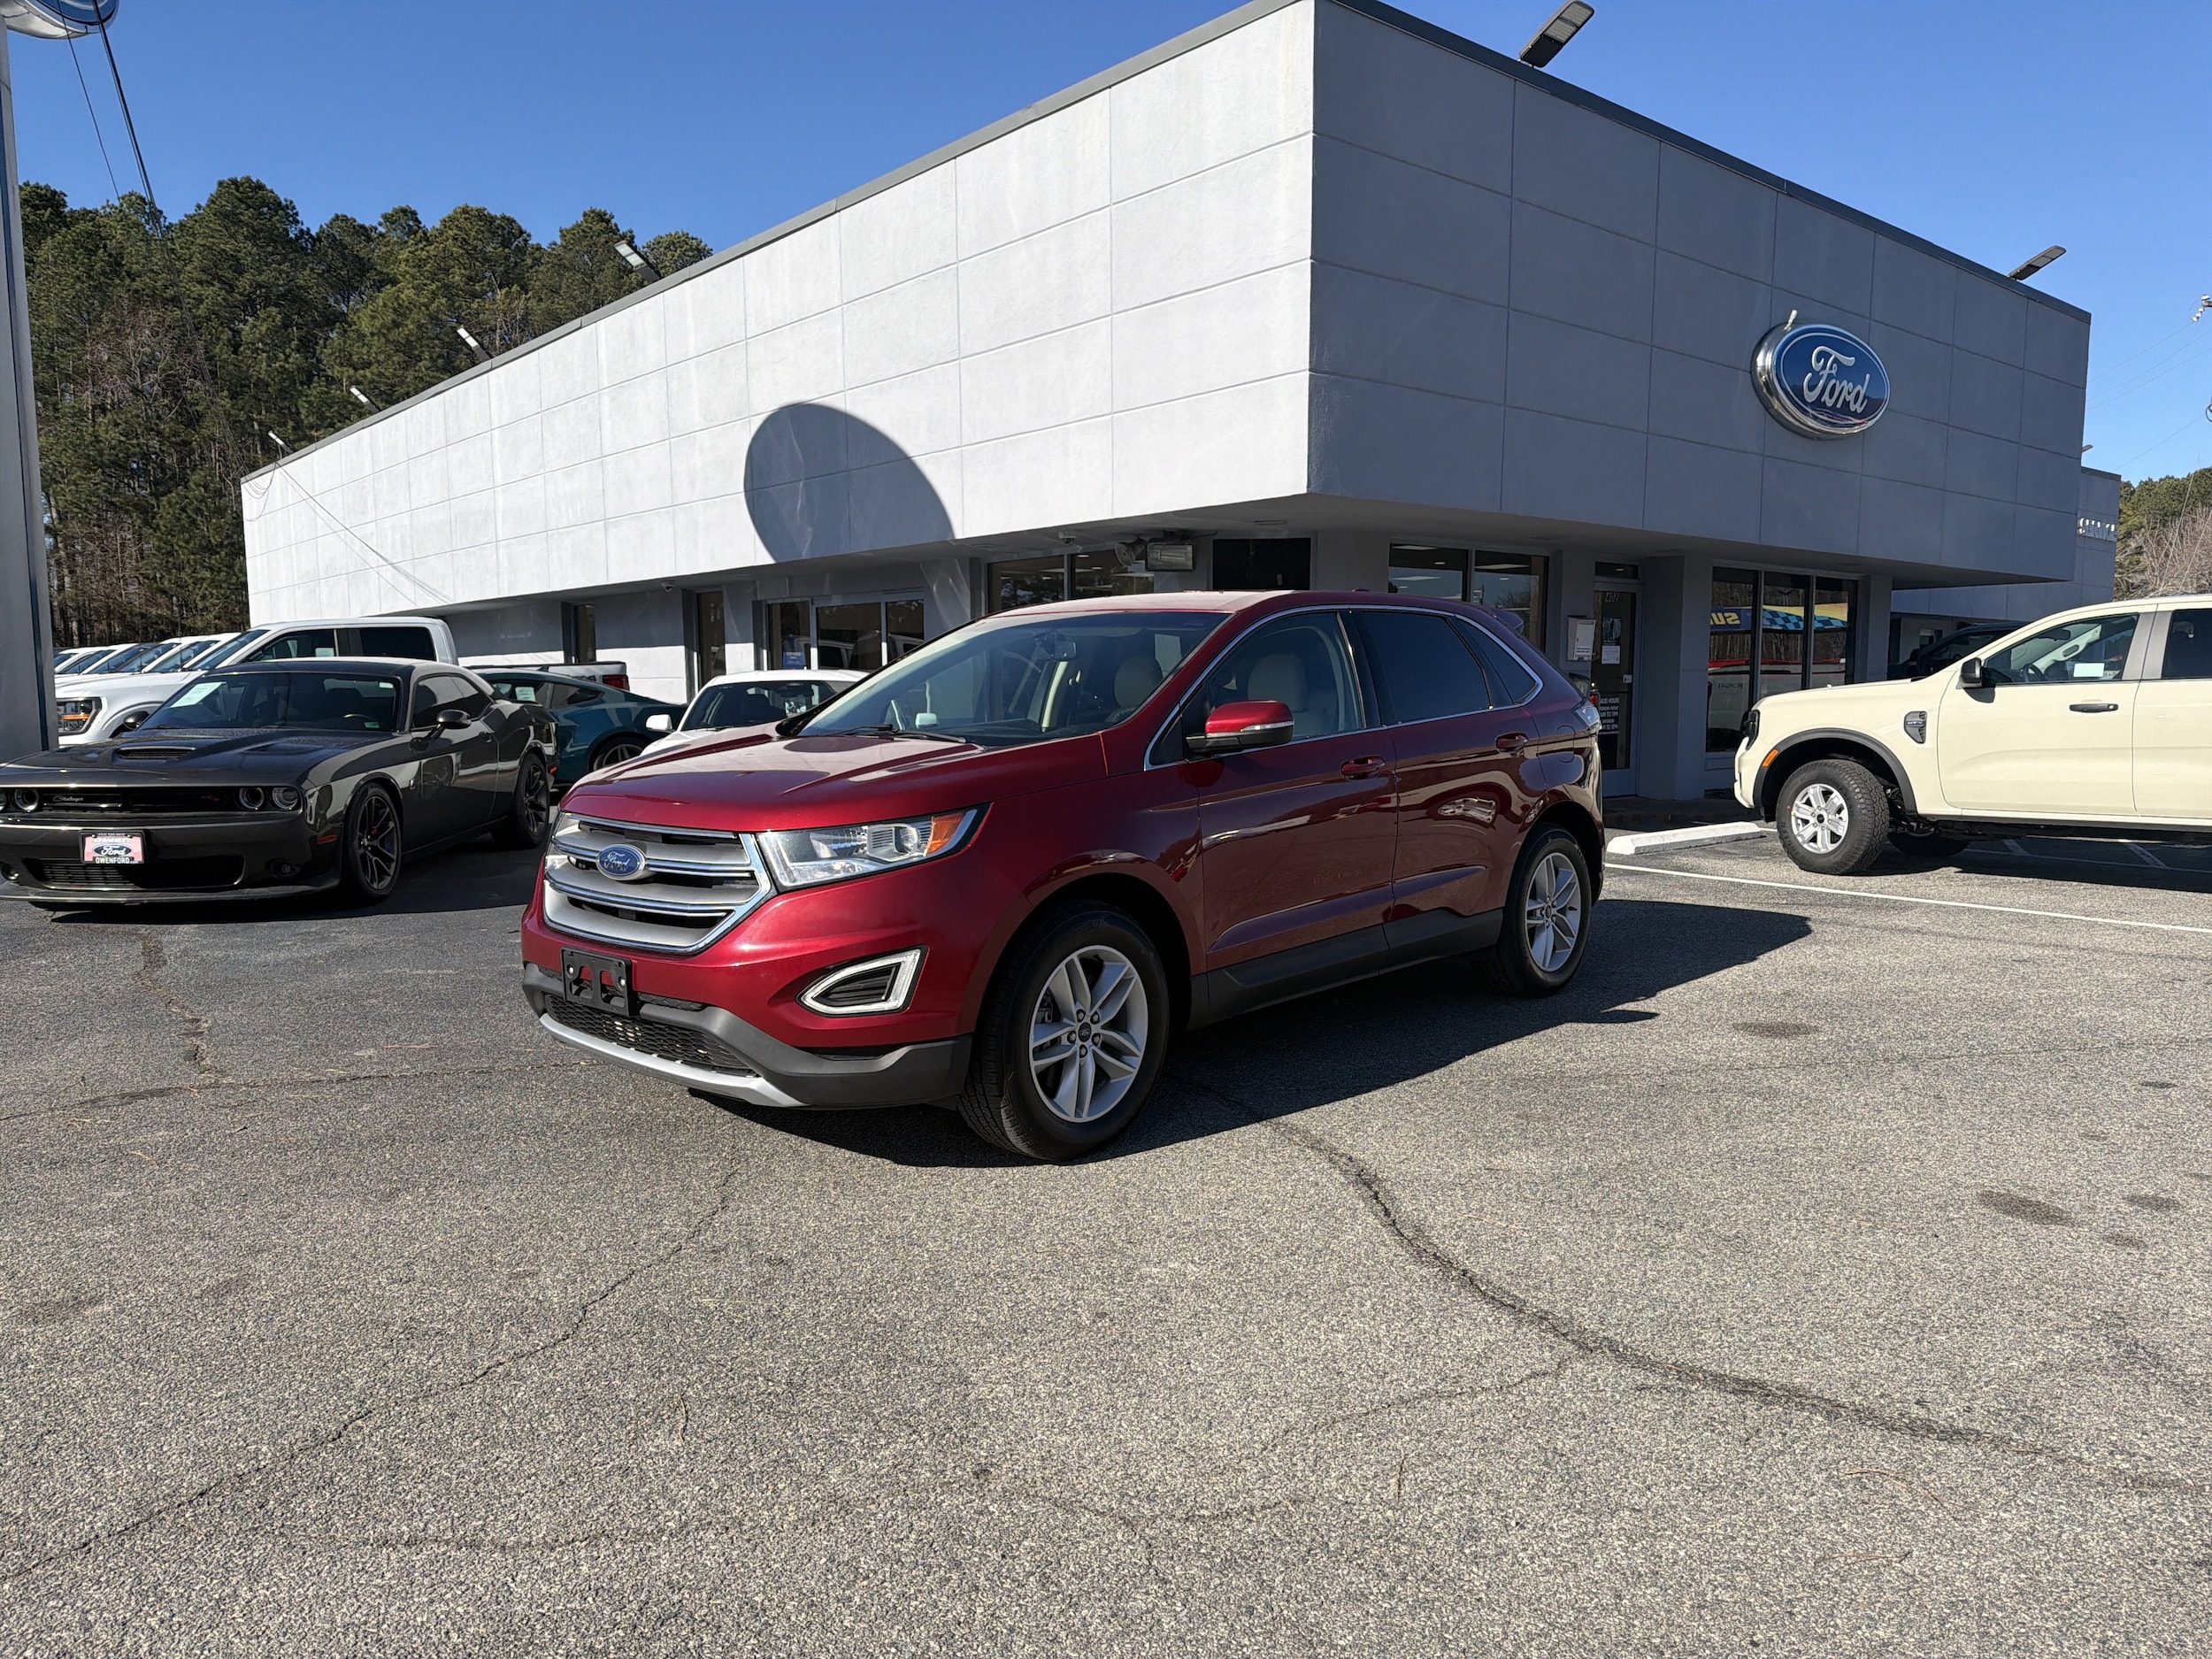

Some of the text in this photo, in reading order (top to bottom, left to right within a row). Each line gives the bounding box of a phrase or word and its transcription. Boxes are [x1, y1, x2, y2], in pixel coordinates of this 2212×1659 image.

[1802, 345, 1871, 414] Ford
[101, 845, 127, 856] Ford
[603, 851, 631, 872] Ford
